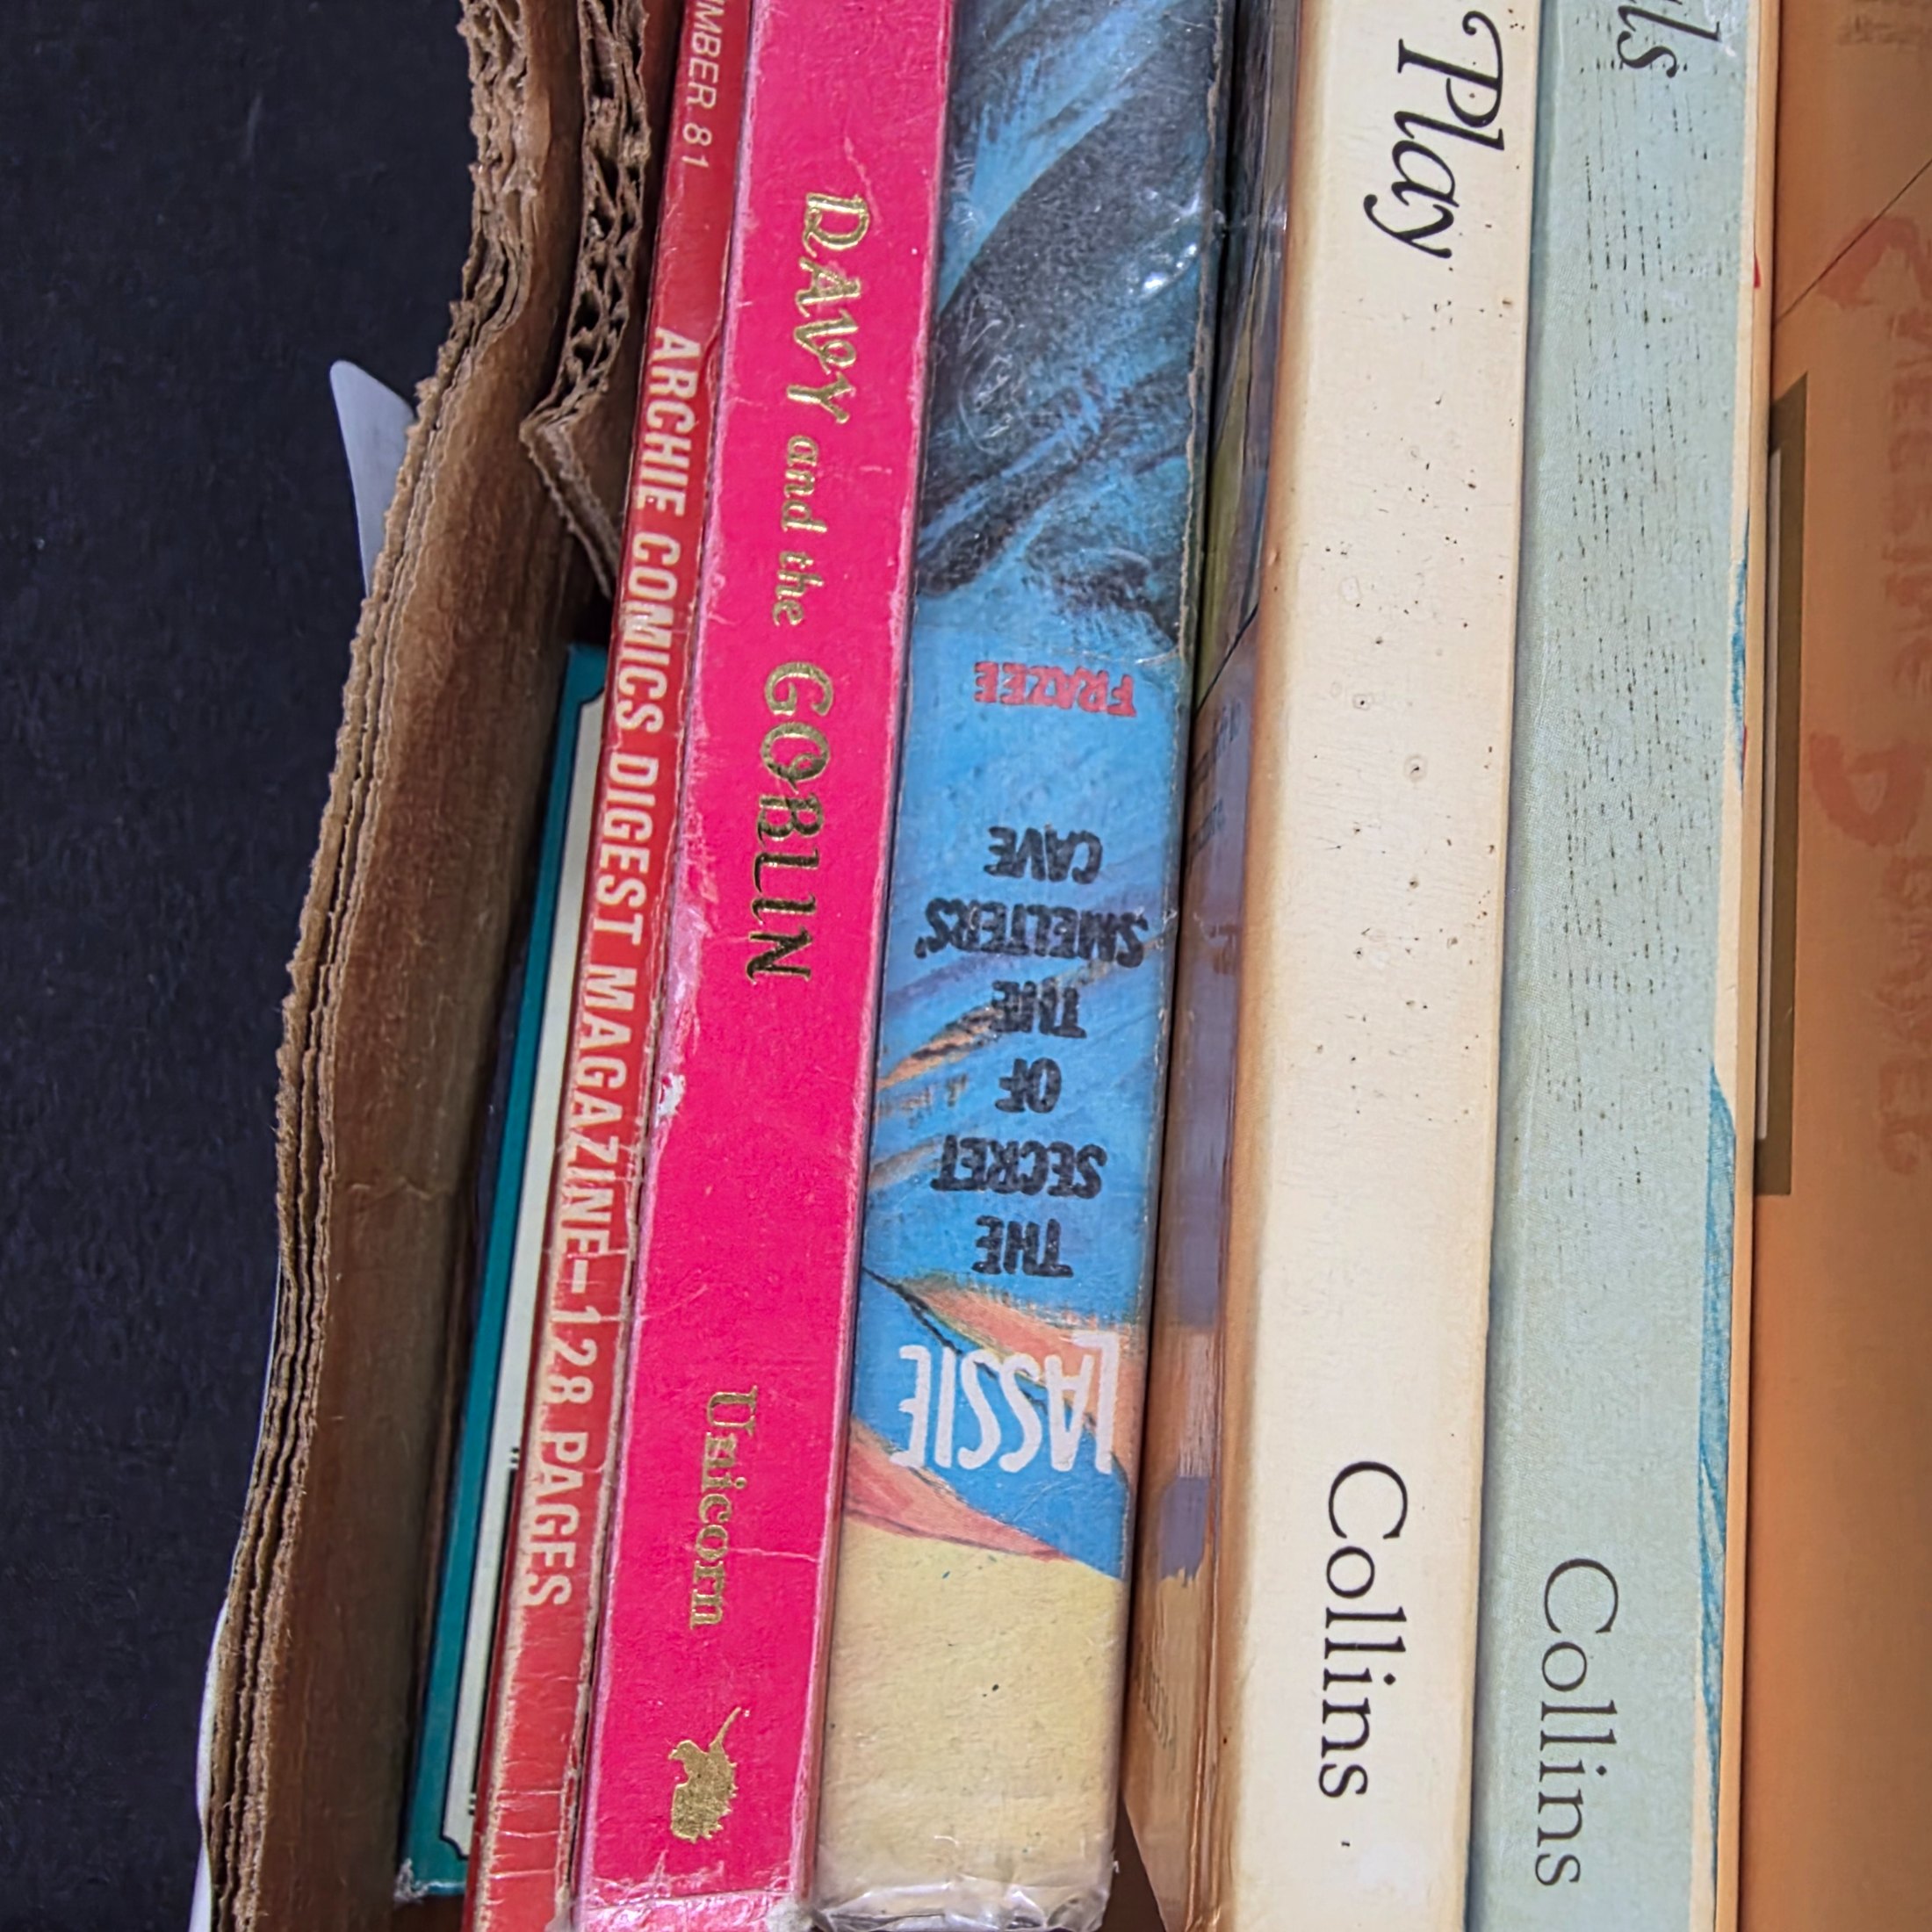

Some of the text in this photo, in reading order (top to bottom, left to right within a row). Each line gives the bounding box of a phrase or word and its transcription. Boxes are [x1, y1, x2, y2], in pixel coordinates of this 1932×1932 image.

[685, 0, 725, 110] MBER
[1618, 0, 1721, 78] ls
[1363, 11, 1505, 259] Play
[636, 327, 701, 516] ARCHIE
[615, 533, 681, 734] COMICS
[746, 192, 869, 985] DAVY and the GOBLIN
[974, 660, 1137, 717] FRAZEE
[593, 753, 660, 946] DIGEST
[984, 825, 1104, 884] CAVE
[990, 977, 1088, 1040] THE
[995, 1056, 1063, 1114] OF
[931, 1134, 1107, 1199] SECRET
[971, 1215, 1074, 1278] THE
[890, 1330, 1121, 1474] LASSIE
[524, 1431, 588, 1607] PAGES
[688, 1384, 757, 1631] Unicorn
[1319, 1460, 1409, 1799] Collins
[1535, 1558, 1619, 1886] Collins
